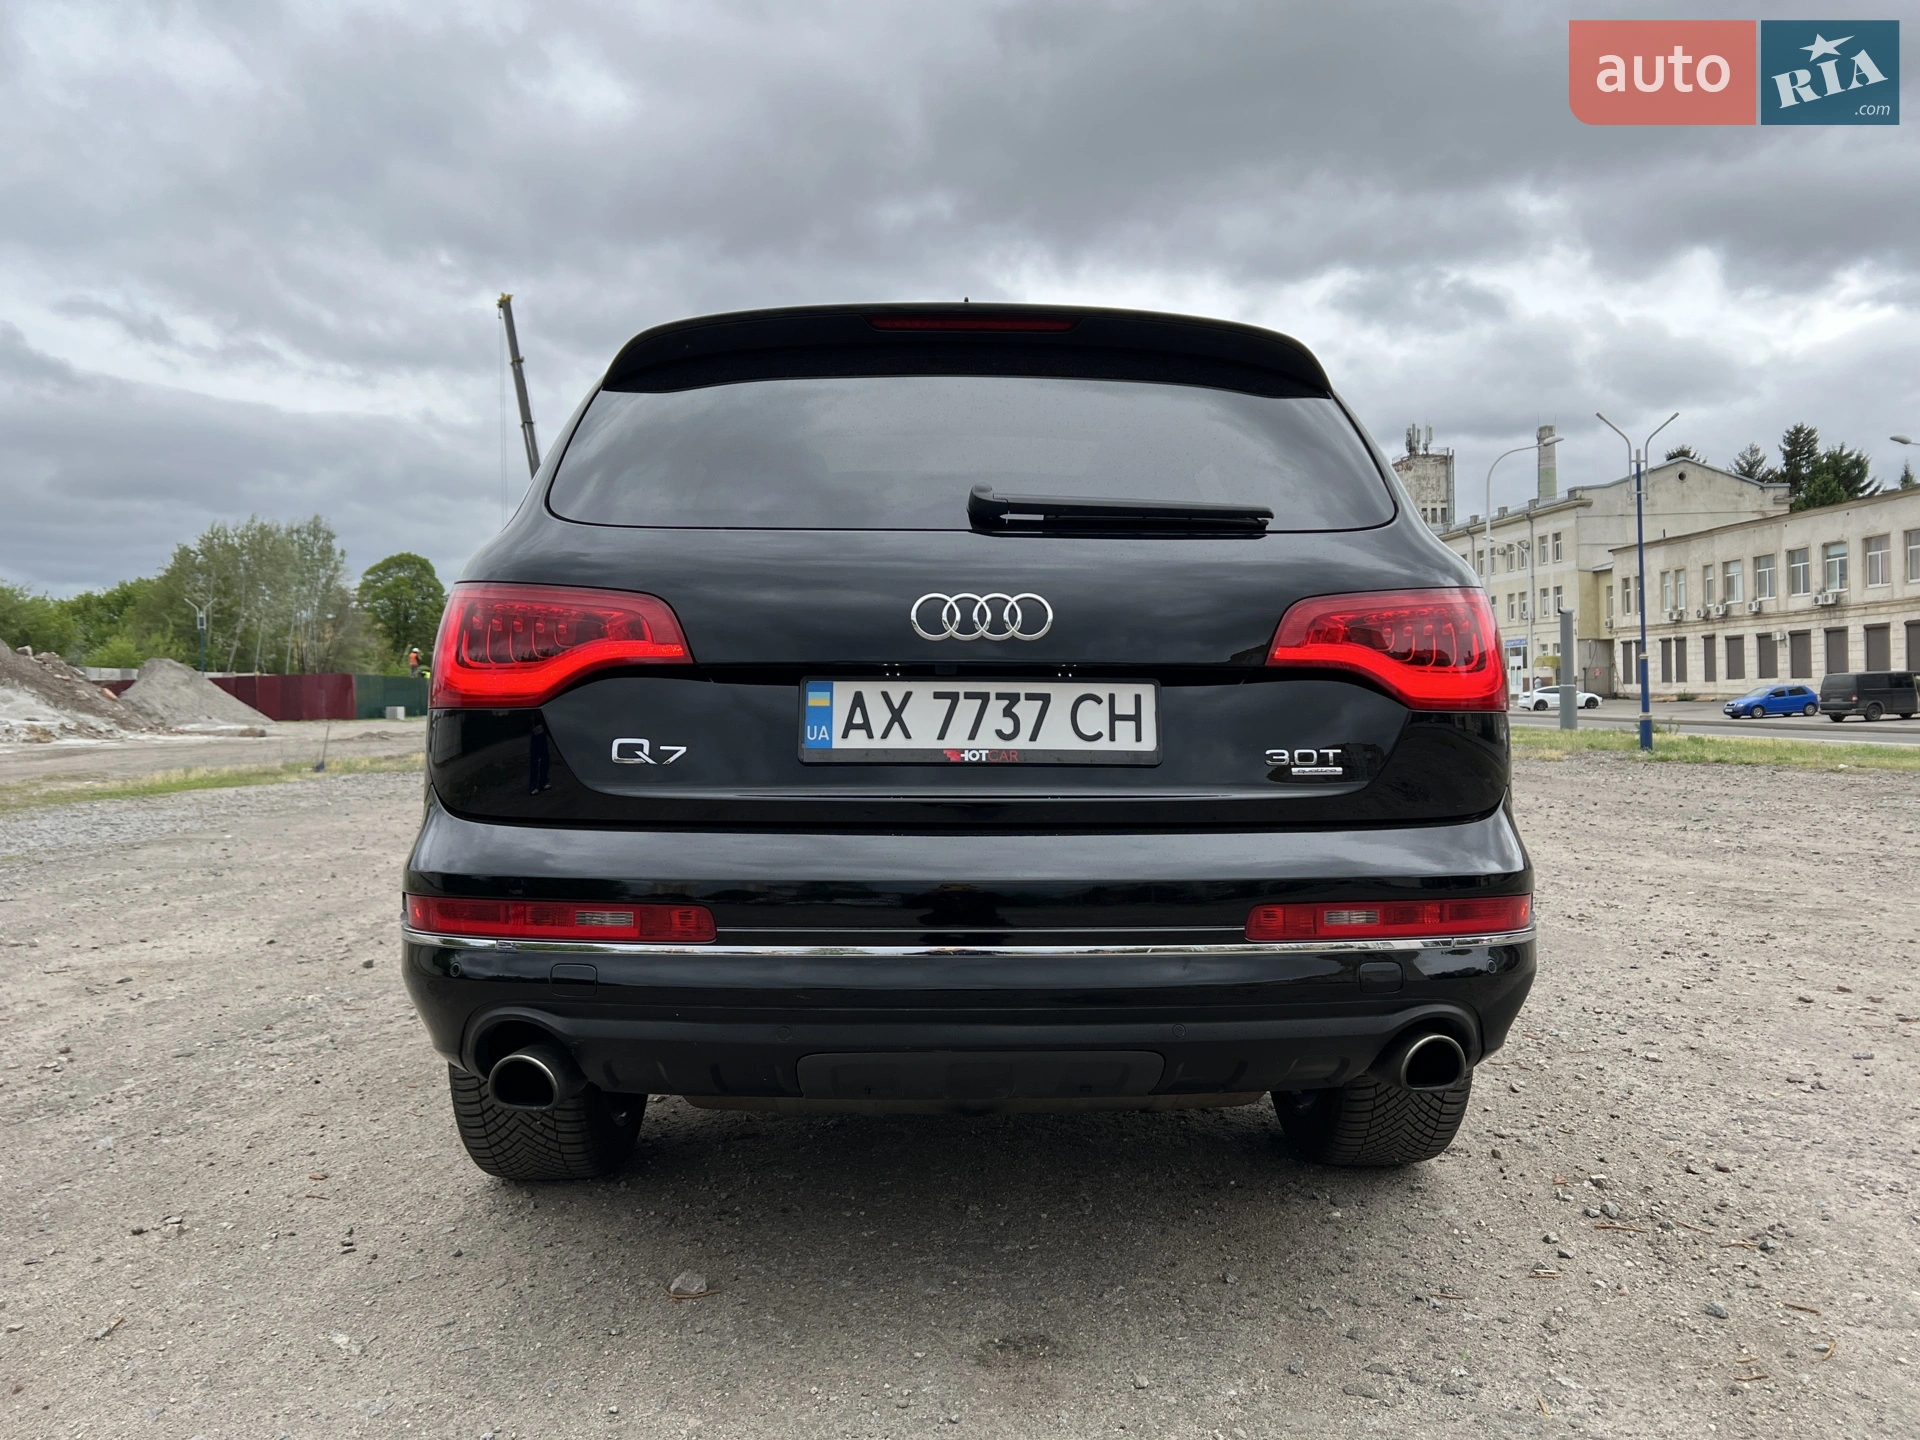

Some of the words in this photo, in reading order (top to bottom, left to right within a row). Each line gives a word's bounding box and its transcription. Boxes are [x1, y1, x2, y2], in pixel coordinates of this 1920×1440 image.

[841, 690, 913, 740] AX
[933, 691, 1052, 742] 7737
[1070, 692, 1142, 743] CH
[806, 725, 830, 741] UA
[611, 738, 687, 765] Q7
[1265, 749, 1342, 766] 3.0T
